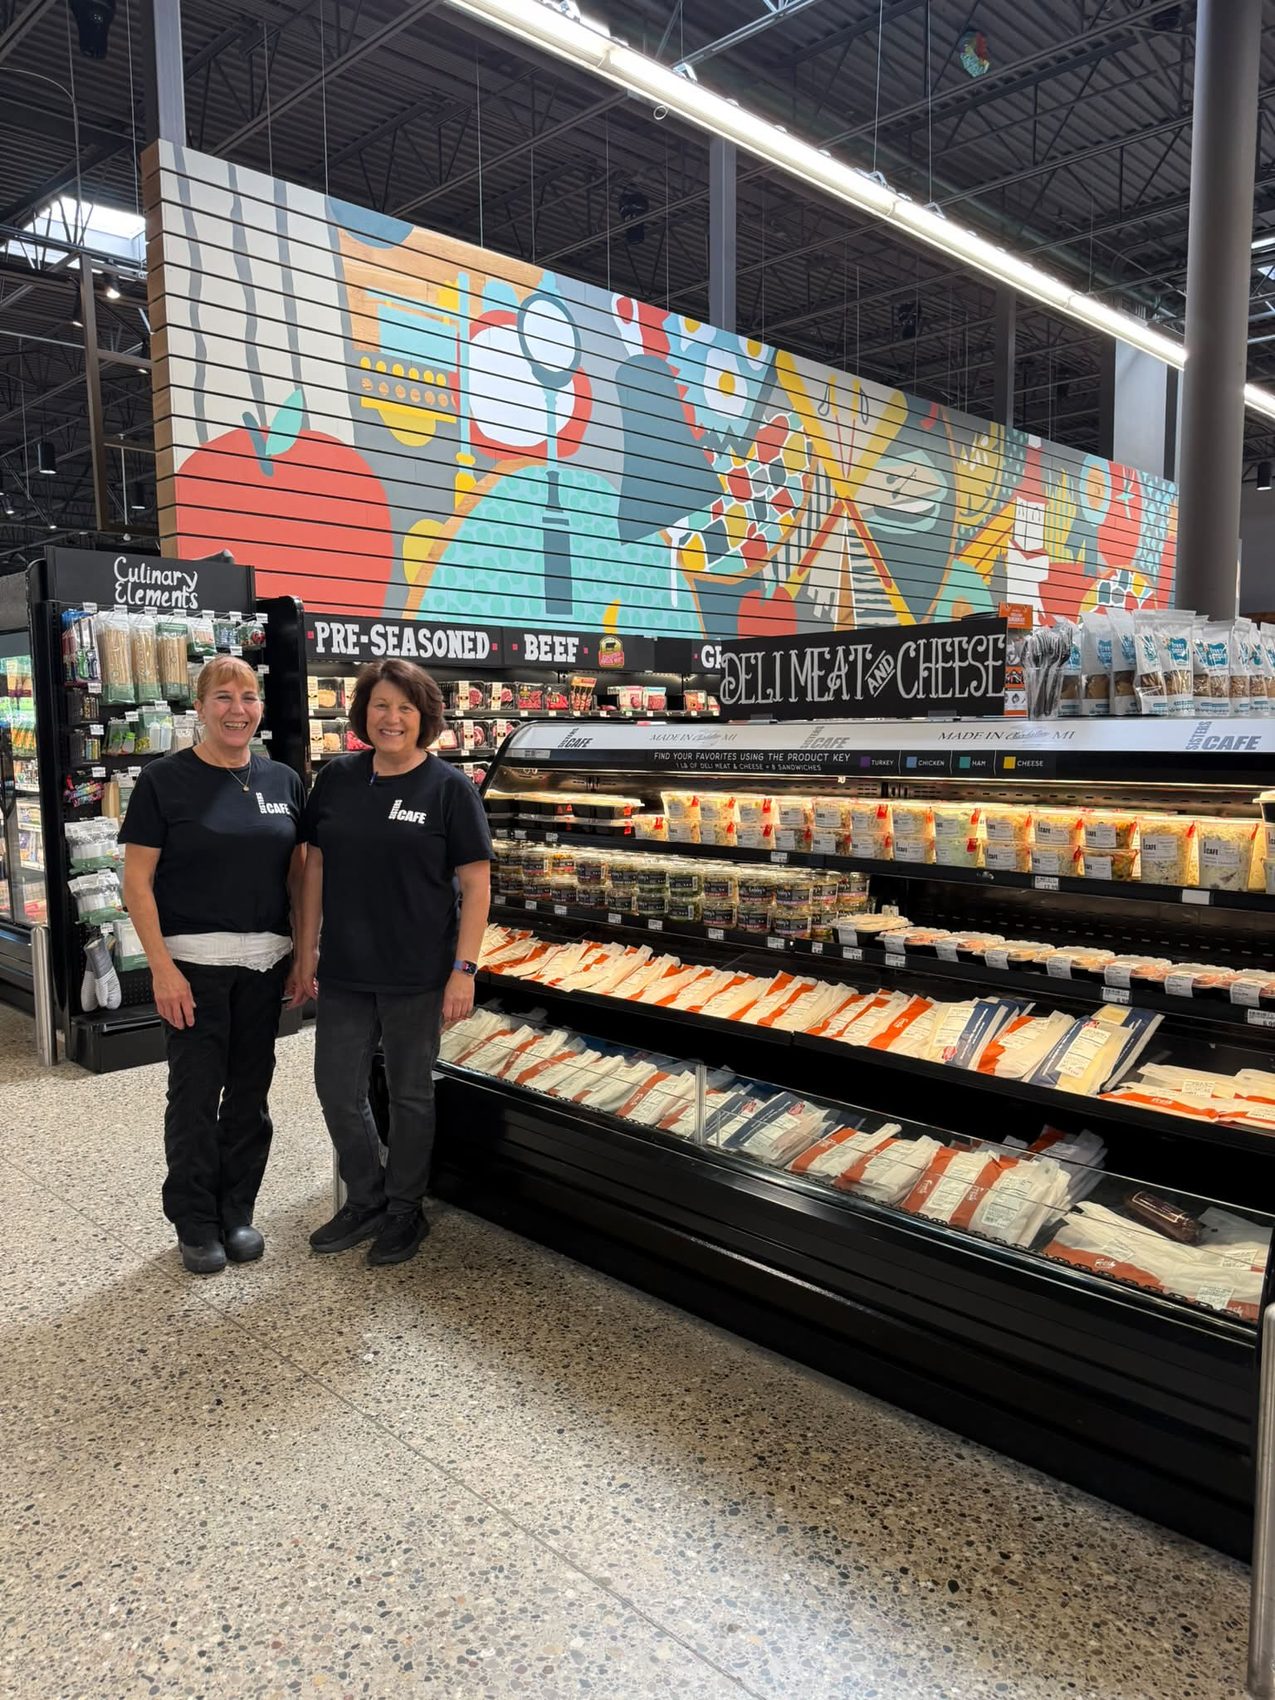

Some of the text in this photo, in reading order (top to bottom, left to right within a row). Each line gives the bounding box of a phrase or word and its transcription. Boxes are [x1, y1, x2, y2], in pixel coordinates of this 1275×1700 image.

[114, 556, 198, 592] Culinary
[115, 581, 198, 609] Elements
[315, 621, 490, 659] PRE-SEASONED
[523, 634, 579, 663] BEEF
[719, 634, 1005, 705] DELI MEAT AND CHEESE
[565, 737, 594, 748] CAFE
[810, 736, 850, 748] CAFE
[938, 731, 984, 740] MADE
[985, 731, 1003, 740] IN
[1053, 730, 1075, 740] MI
[1185, 721, 1212, 750] SISTERS
[1201, 735, 1262, 750] CAFE
[654, 752, 851, 762] FIND YOUR FAVORITES USING THE PRODUCT KEY
[266, 802, 290, 815] CAFE
[397, 809, 427, 824] CAFE
